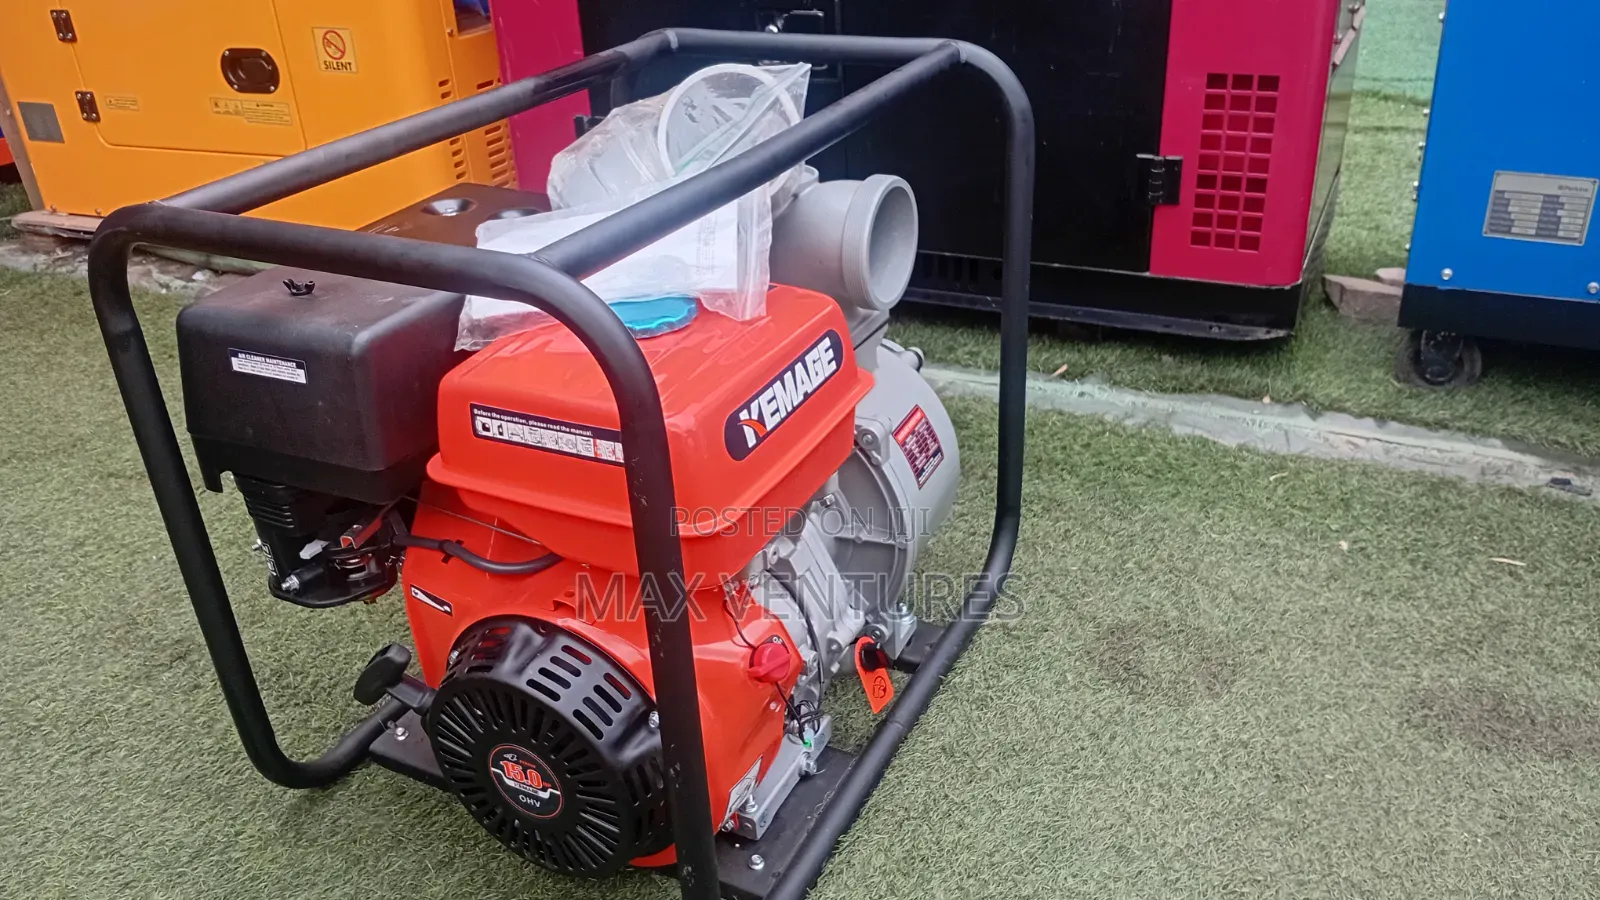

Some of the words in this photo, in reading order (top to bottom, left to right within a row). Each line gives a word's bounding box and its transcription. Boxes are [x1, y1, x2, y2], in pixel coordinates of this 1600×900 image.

[323, 60, 352, 71] SILENT
[246, 354, 264, 362] CLEANER
[265, 357, 296, 368] MAINTENANCE
[737, 336, 837, 448] KEMAGE
[473, 408, 491, 417] Before
[491, 412, 501, 420] the
[501, 415, 528, 425] operation,
[528, 420, 547, 429] please
[547, 423, 560, 431] read
[560, 425, 570, 433] the
[570, 428, 593, 436] manual.
[500, 760, 542, 789] 15.0
[519, 794, 540, 807] OHV
